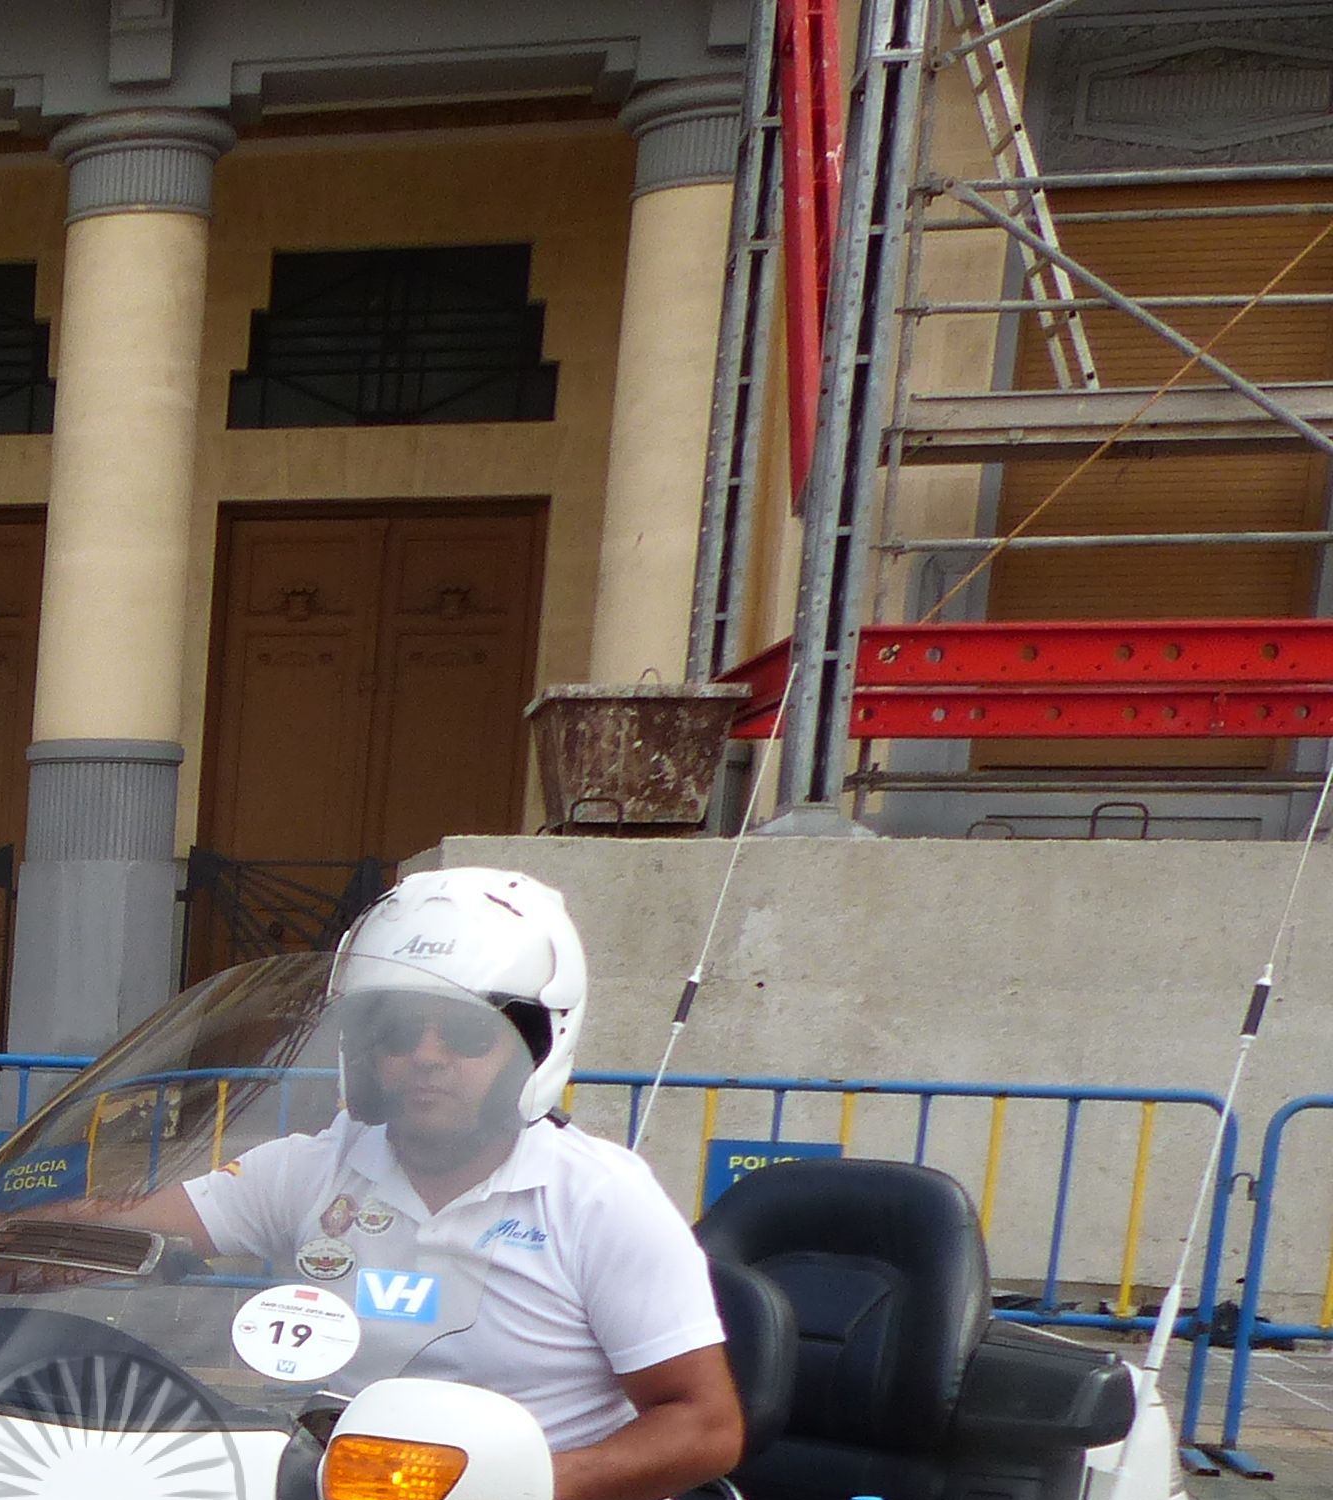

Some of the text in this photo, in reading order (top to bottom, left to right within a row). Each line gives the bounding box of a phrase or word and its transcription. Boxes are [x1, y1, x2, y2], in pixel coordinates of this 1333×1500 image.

[392, 934, 456, 955] Arai
[4, 1159, 67, 1178] POLICIA
[3, 1174, 59, 1193] LOCAL
[364, 1272, 435, 1315] VH
[269, 1320, 313, 1348] 19
